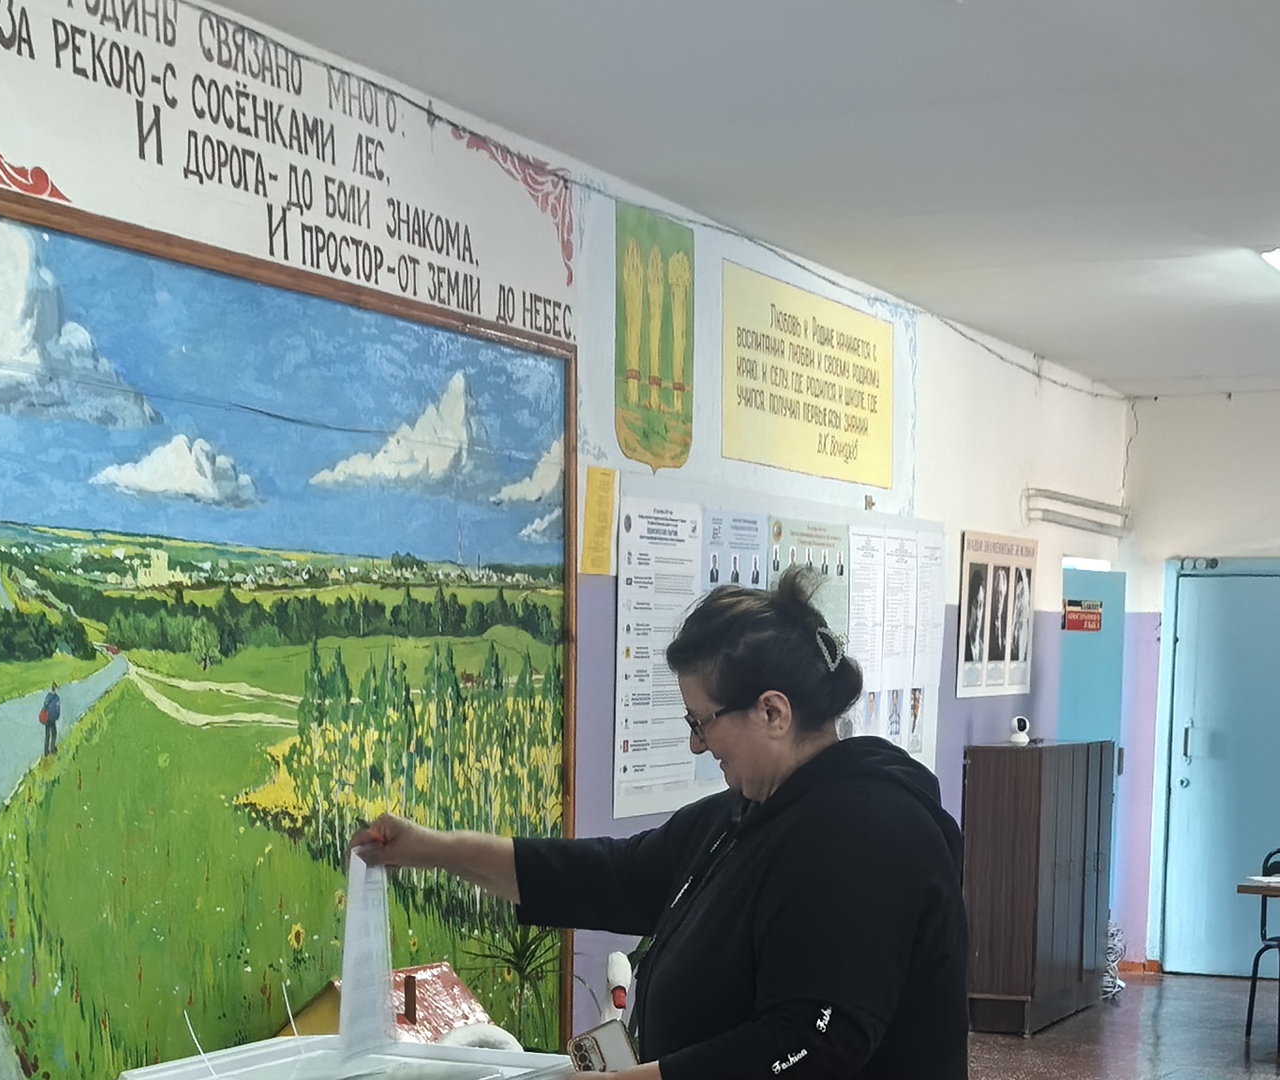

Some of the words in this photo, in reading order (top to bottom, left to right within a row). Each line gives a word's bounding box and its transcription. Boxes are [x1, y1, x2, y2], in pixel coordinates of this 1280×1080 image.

[67, 0, 178, 47] ДИНЫ
[198, 11, 303, 96] СВЯЗАНО
[135, 99, 163, 165] И
[286, 163, 313, 216] ДО
[324, 174, 371, 229] БОЛИ
[192, 74, 336, 166] СОСЁНКАМИ
[352, 133, 390, 186] ЛЕС,
[267, 203, 289, 261] И
[427, 262, 481, 315] ЗЕМЛИ
[496, 284, 515, 325] ДО
[522, 291, 577, 340] НЕБЕС.
[771, 1048, 808, 1075] Fashion
